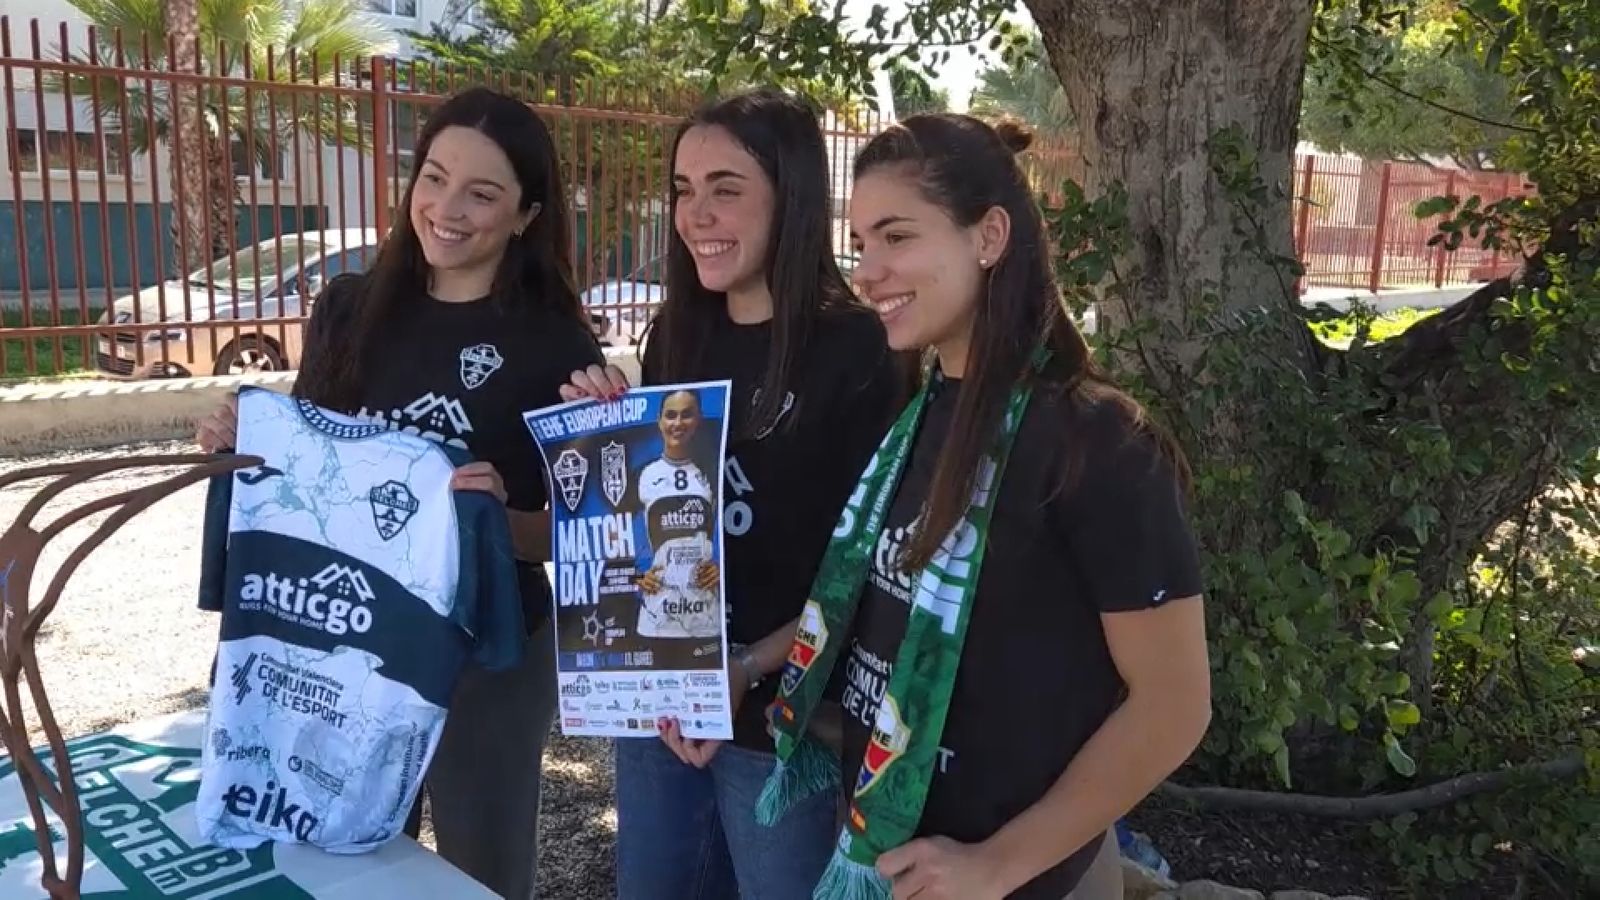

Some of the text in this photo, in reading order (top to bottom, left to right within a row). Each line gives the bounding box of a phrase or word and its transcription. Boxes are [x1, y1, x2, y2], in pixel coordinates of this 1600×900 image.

[563, 401, 622, 433] EUROPEAN
[623, 398, 647, 422] CUP
[674, 469, 688, 490] 8
[558, 512, 635, 562] MATCH
[661, 510, 704, 528] atticgo
[241, 571, 373, 635] atticgo
[560, 560, 605, 606] DAY
[663, 597, 704, 614] teika
[258, 664, 341, 707] COMUNITAT
[263, 681, 347, 728] DE L'ESPORT
